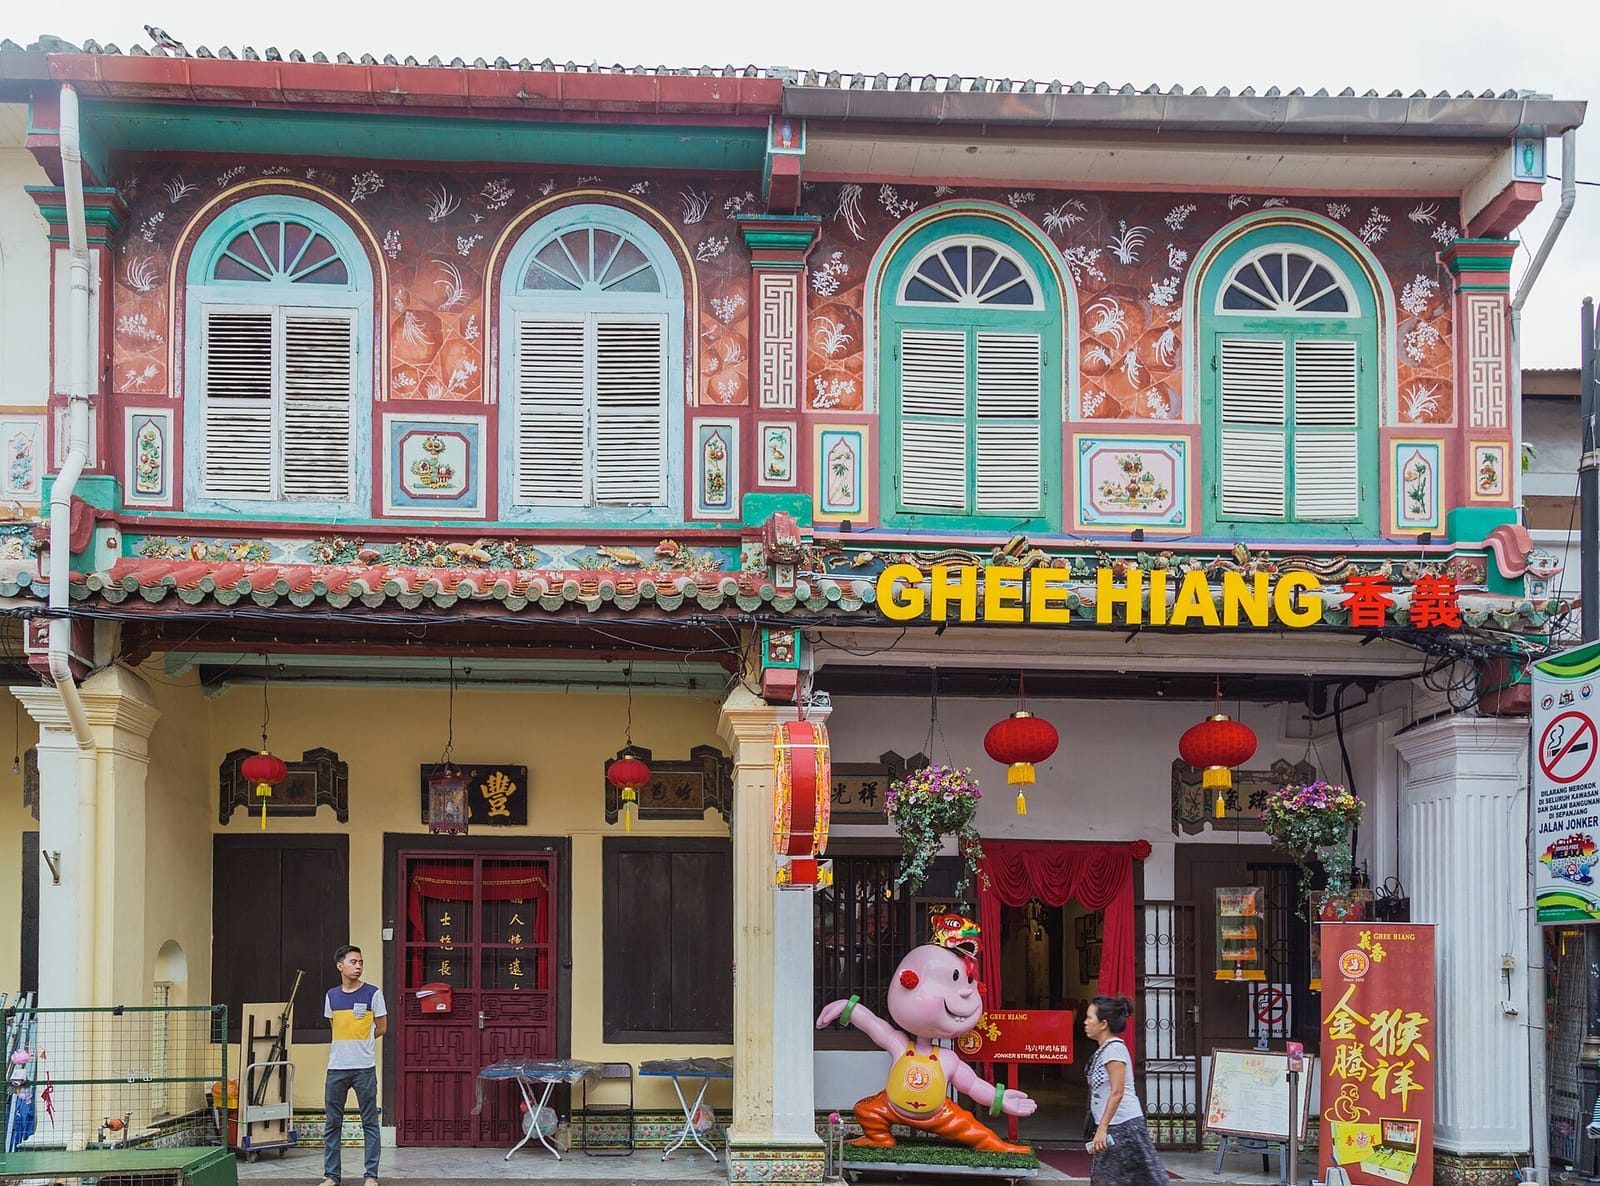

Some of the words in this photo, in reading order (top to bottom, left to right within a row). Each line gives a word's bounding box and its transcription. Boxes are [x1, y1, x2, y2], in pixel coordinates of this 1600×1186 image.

[876, 564, 1070, 623] GHEE
[1096, 568, 1321, 627] HIANG
[1540, 787, 1567, 797] DILARANG
[1569, 782, 1596, 792] MEROKOK
[1545, 795, 1570, 804] SELURUH
[1571, 790, 1599, 800] KAWASAN
[1550, 803, 1568, 811] DALAM
[1569, 798, 1600, 808] BANGUNAN
[1556, 808, 1588, 818] SEPANJANG
[1538, 821, 1564, 834] JALAN
[1566, 816, 1599, 830] JONKER
